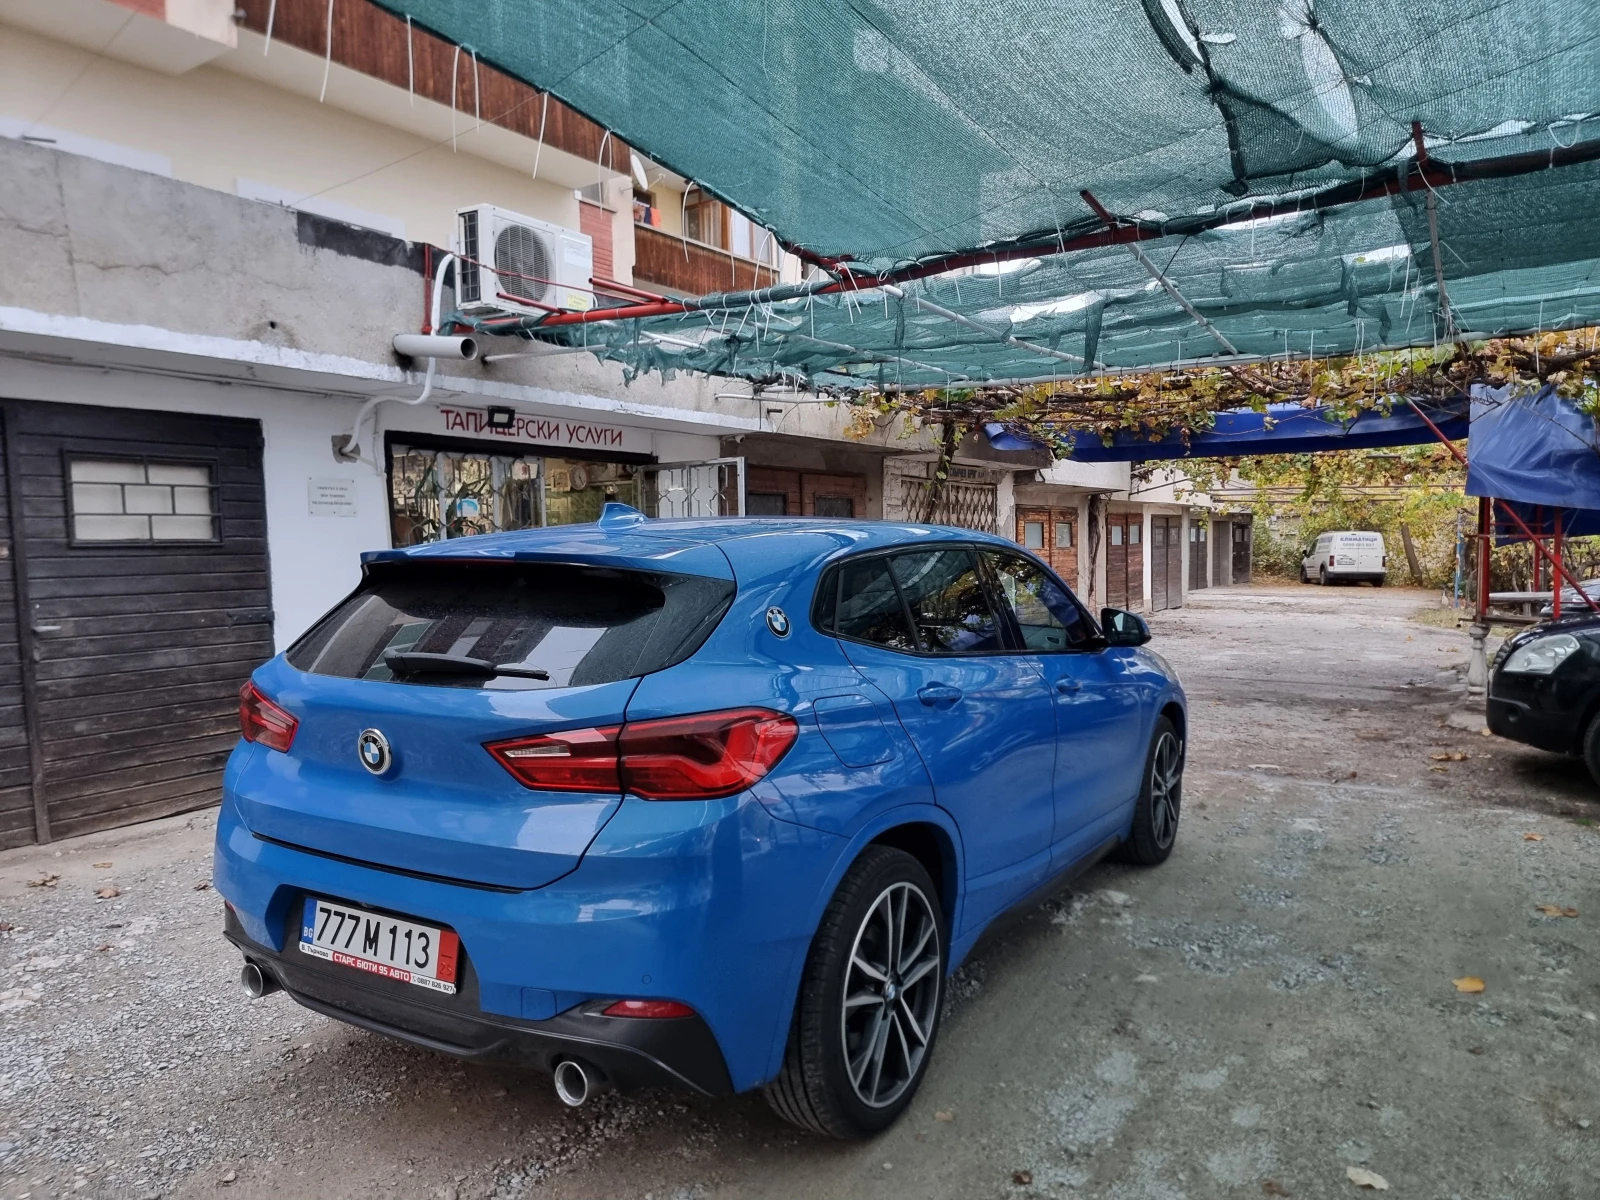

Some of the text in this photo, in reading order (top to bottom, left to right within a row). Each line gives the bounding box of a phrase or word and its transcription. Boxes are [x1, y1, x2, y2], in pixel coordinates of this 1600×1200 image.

[440, 409, 623, 447] ТАПИЕРСКИ УСЛУГИ
[303, 926, 313, 938] BG
[307, 945, 329, 957] Търново
[333, 952, 410, 981] СТАРС БЮТИ 95 АВТО
